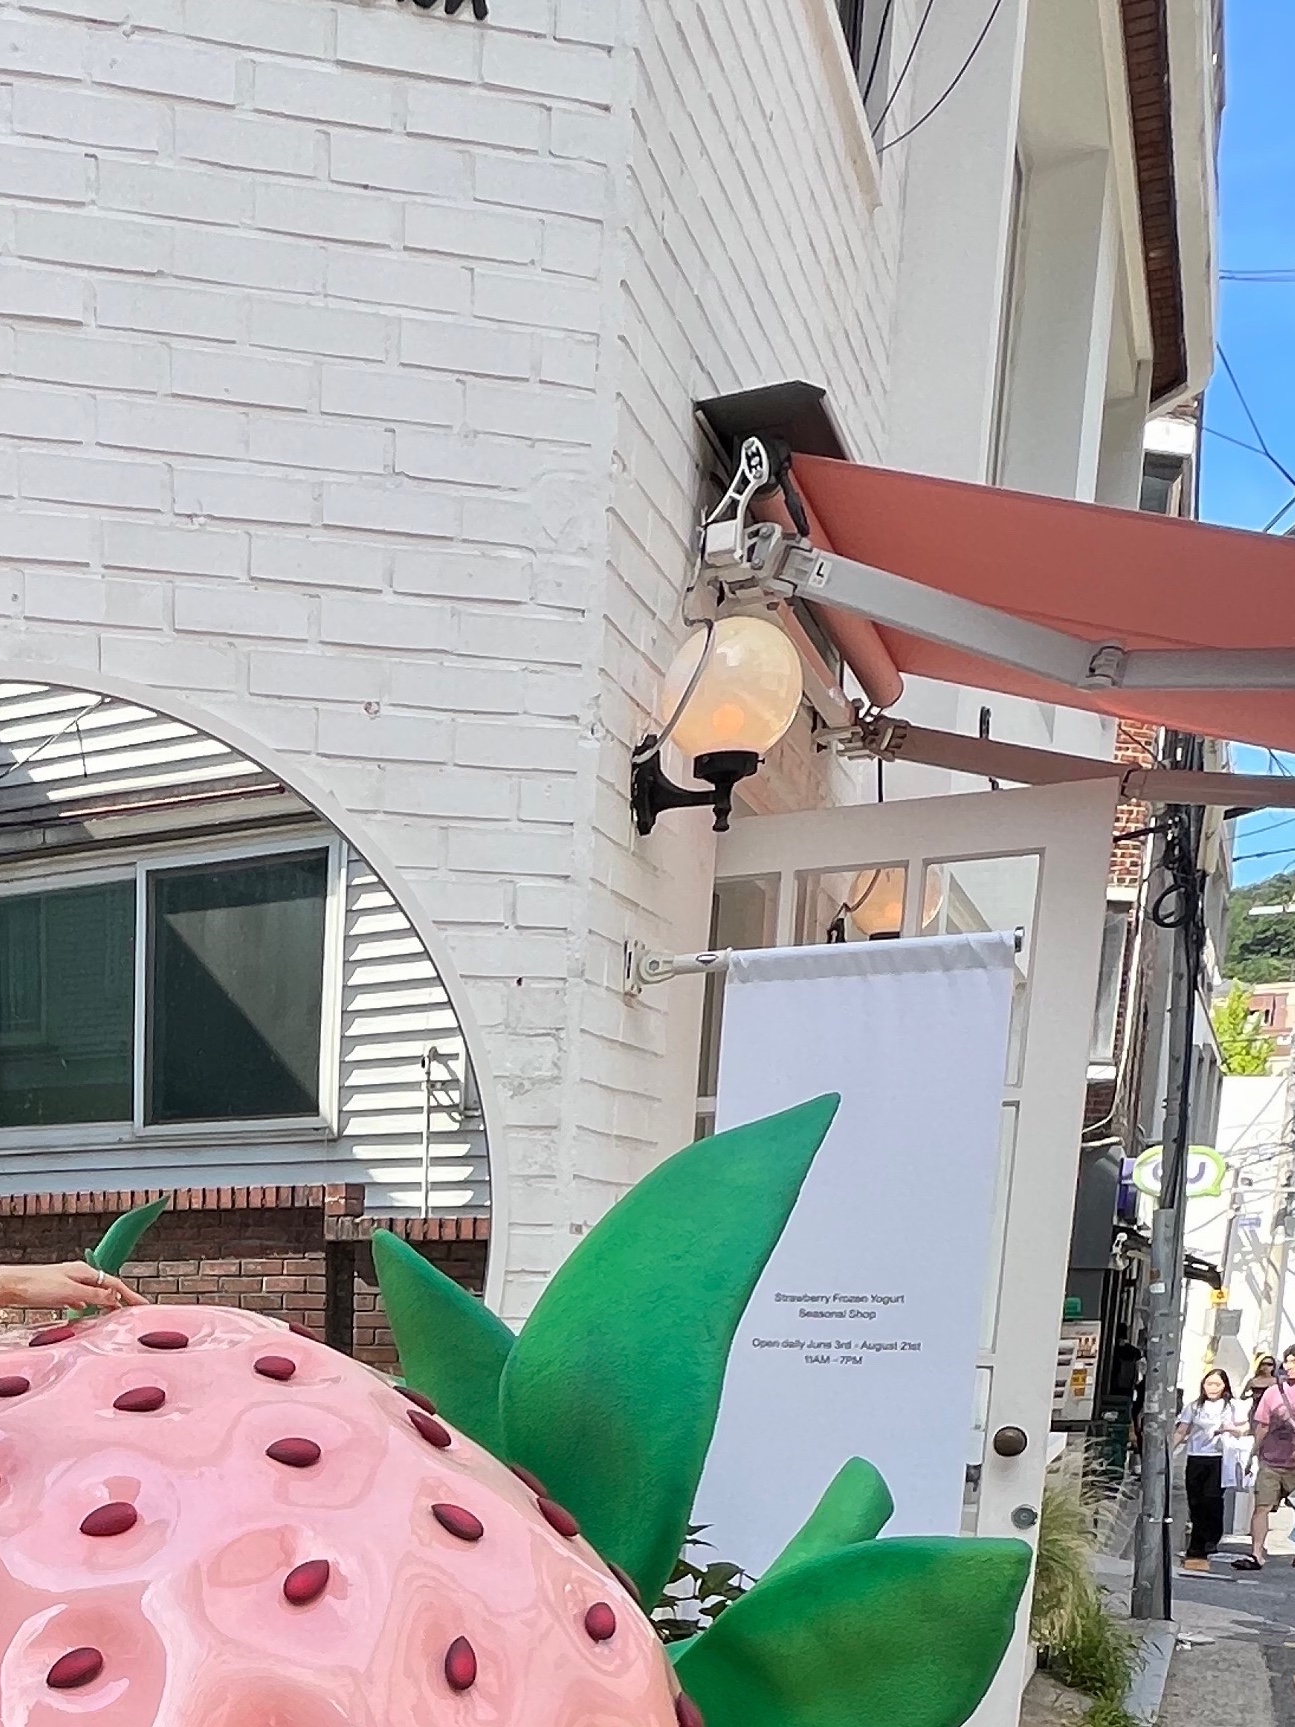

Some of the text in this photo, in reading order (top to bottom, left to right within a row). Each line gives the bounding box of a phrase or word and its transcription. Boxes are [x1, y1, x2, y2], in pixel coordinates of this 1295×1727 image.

[774, 1292, 904, 1305] Strawberry Frozen Yogurt
[798, 1308, 876, 1320] Seasonal Shop
[752, 1338, 780, 1349] Open
[781, 1339, 805, 1350] daily
[807, 1340, 832, 1349] June
[835, 1340, 852, 1350] 3rd
[860, 1340, 898, 1352] August
[900, 1342, 922, 1351] 21st
[805, 1355, 830, 1364] 11AM
[840, 1356, 863, 1365] 7PM
